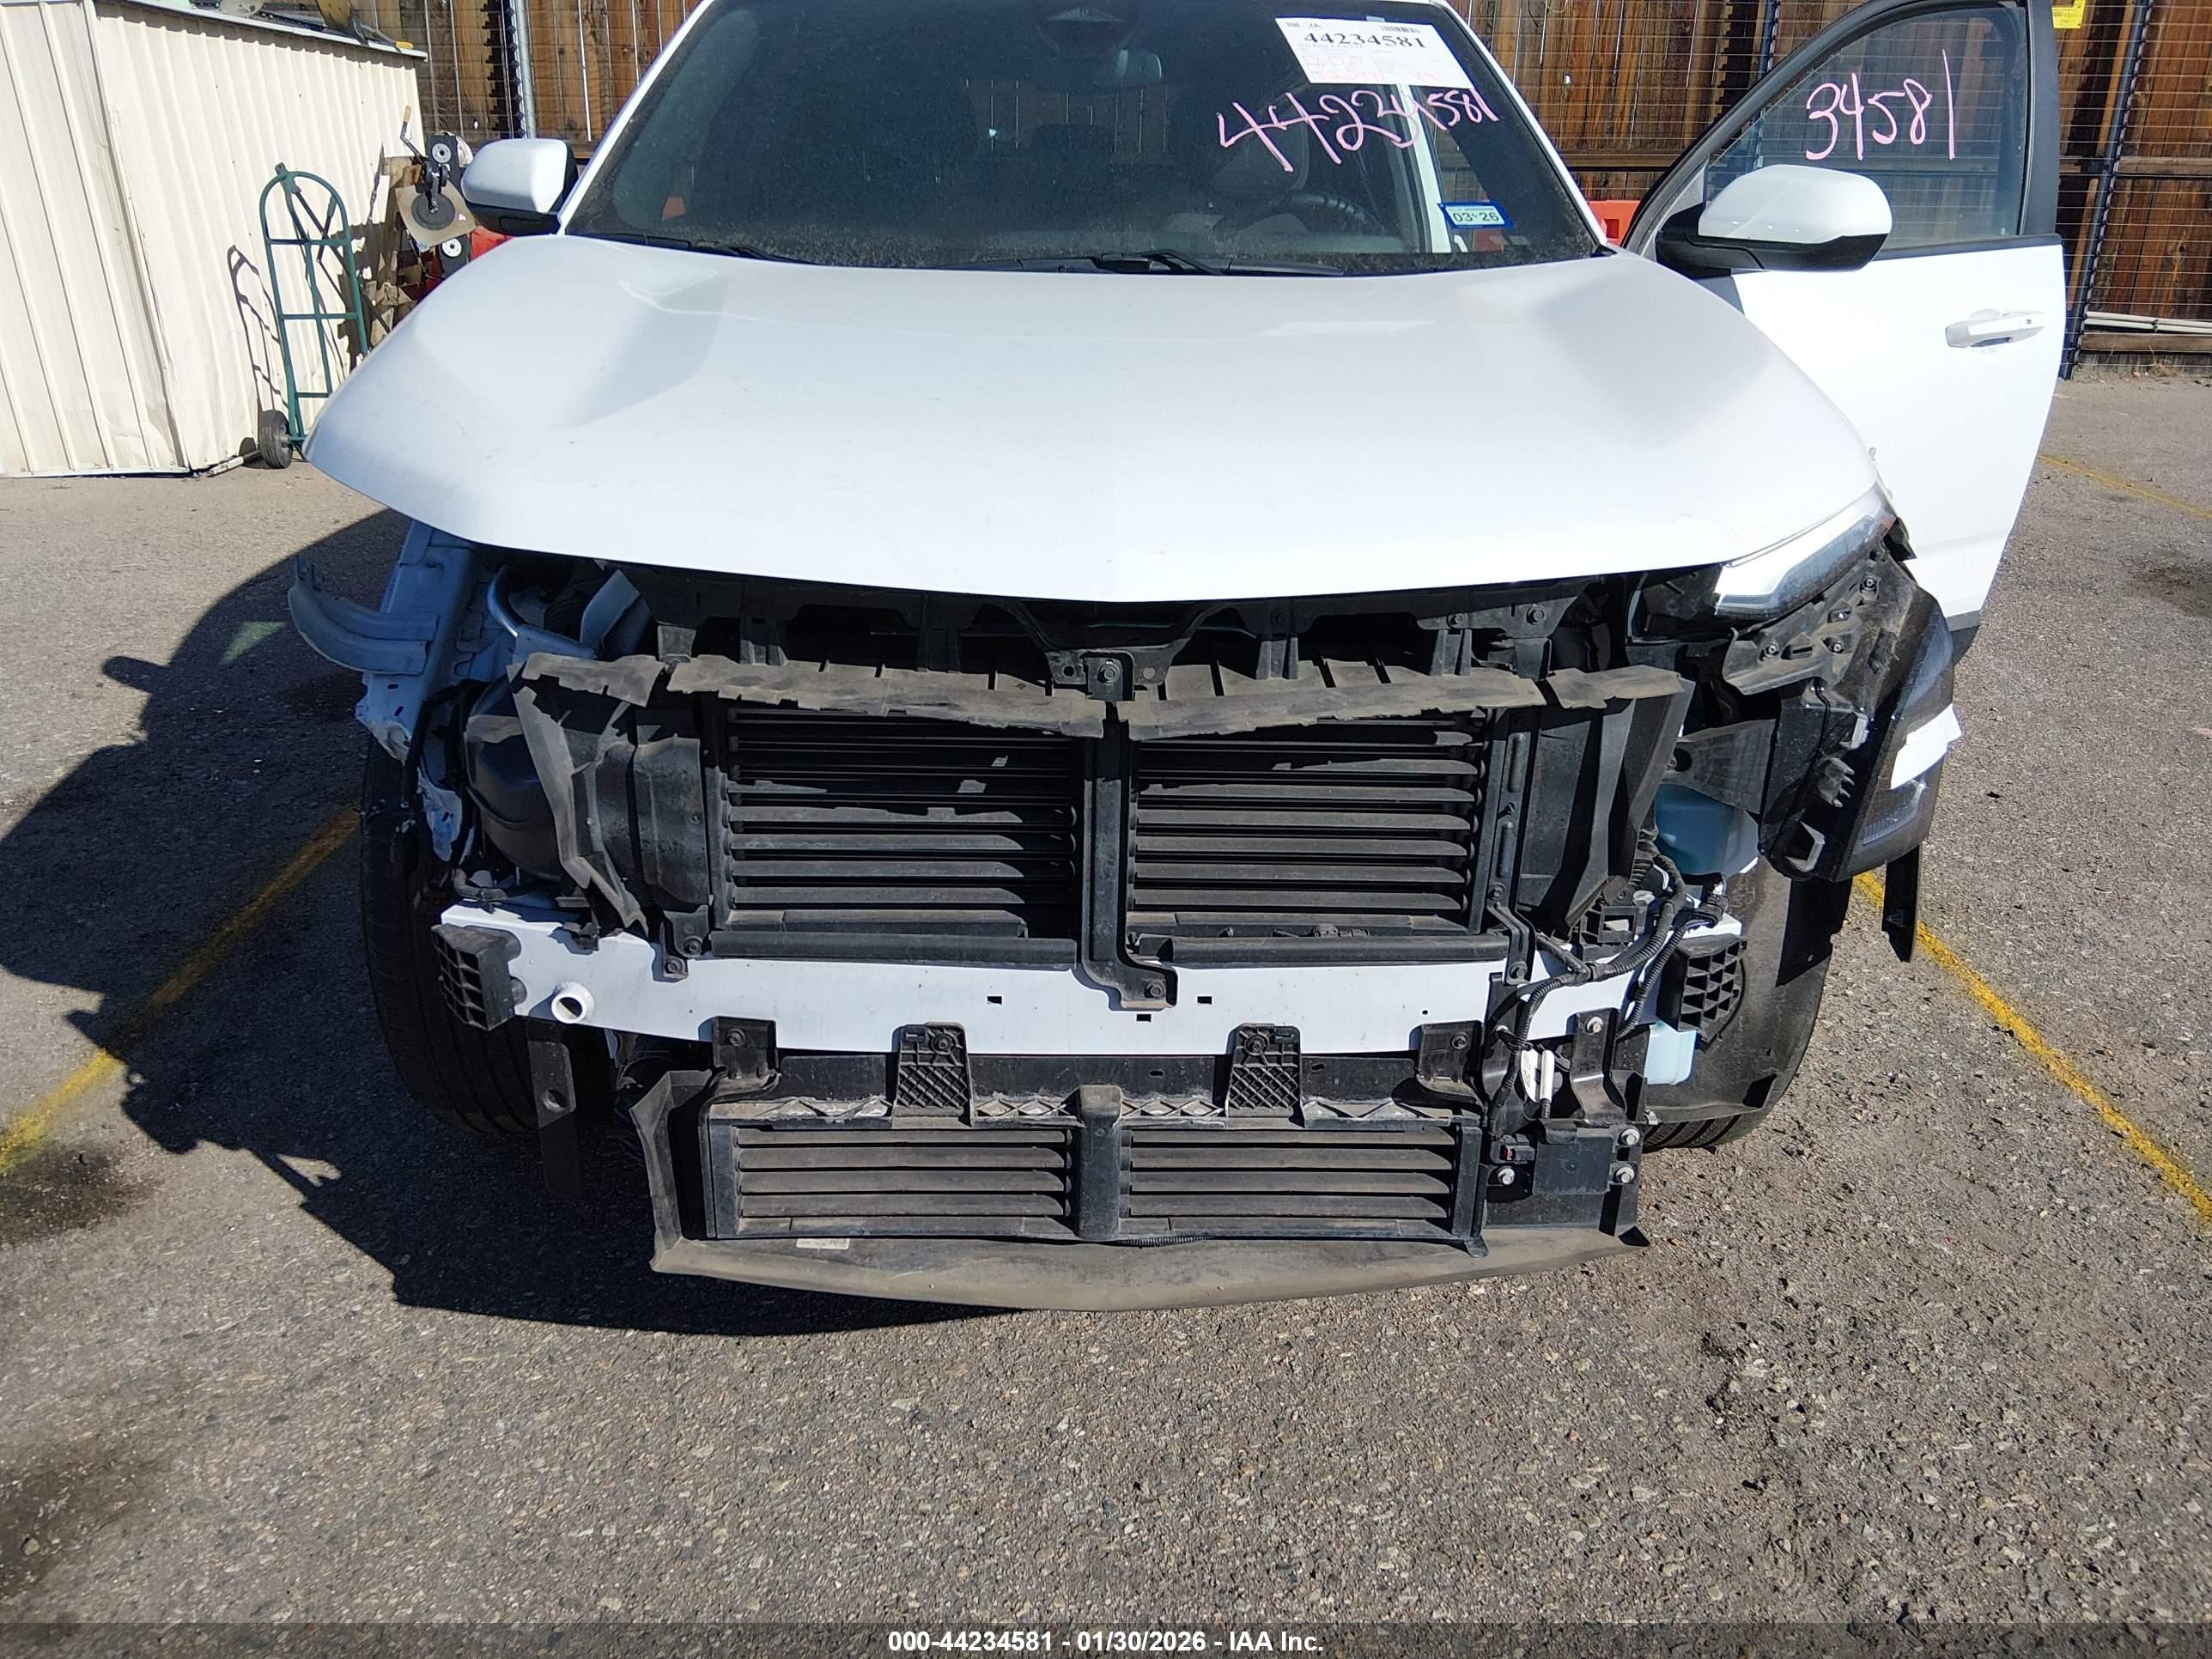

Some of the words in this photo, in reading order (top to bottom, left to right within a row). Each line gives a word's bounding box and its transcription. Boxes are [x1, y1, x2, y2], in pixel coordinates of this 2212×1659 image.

[1304, 32, 1426, 49] 44234581
[1806, 48, 1955, 161] 34581
[1452, 212, 1474, 222] 03
[1479, 211, 1499, 222] 26
